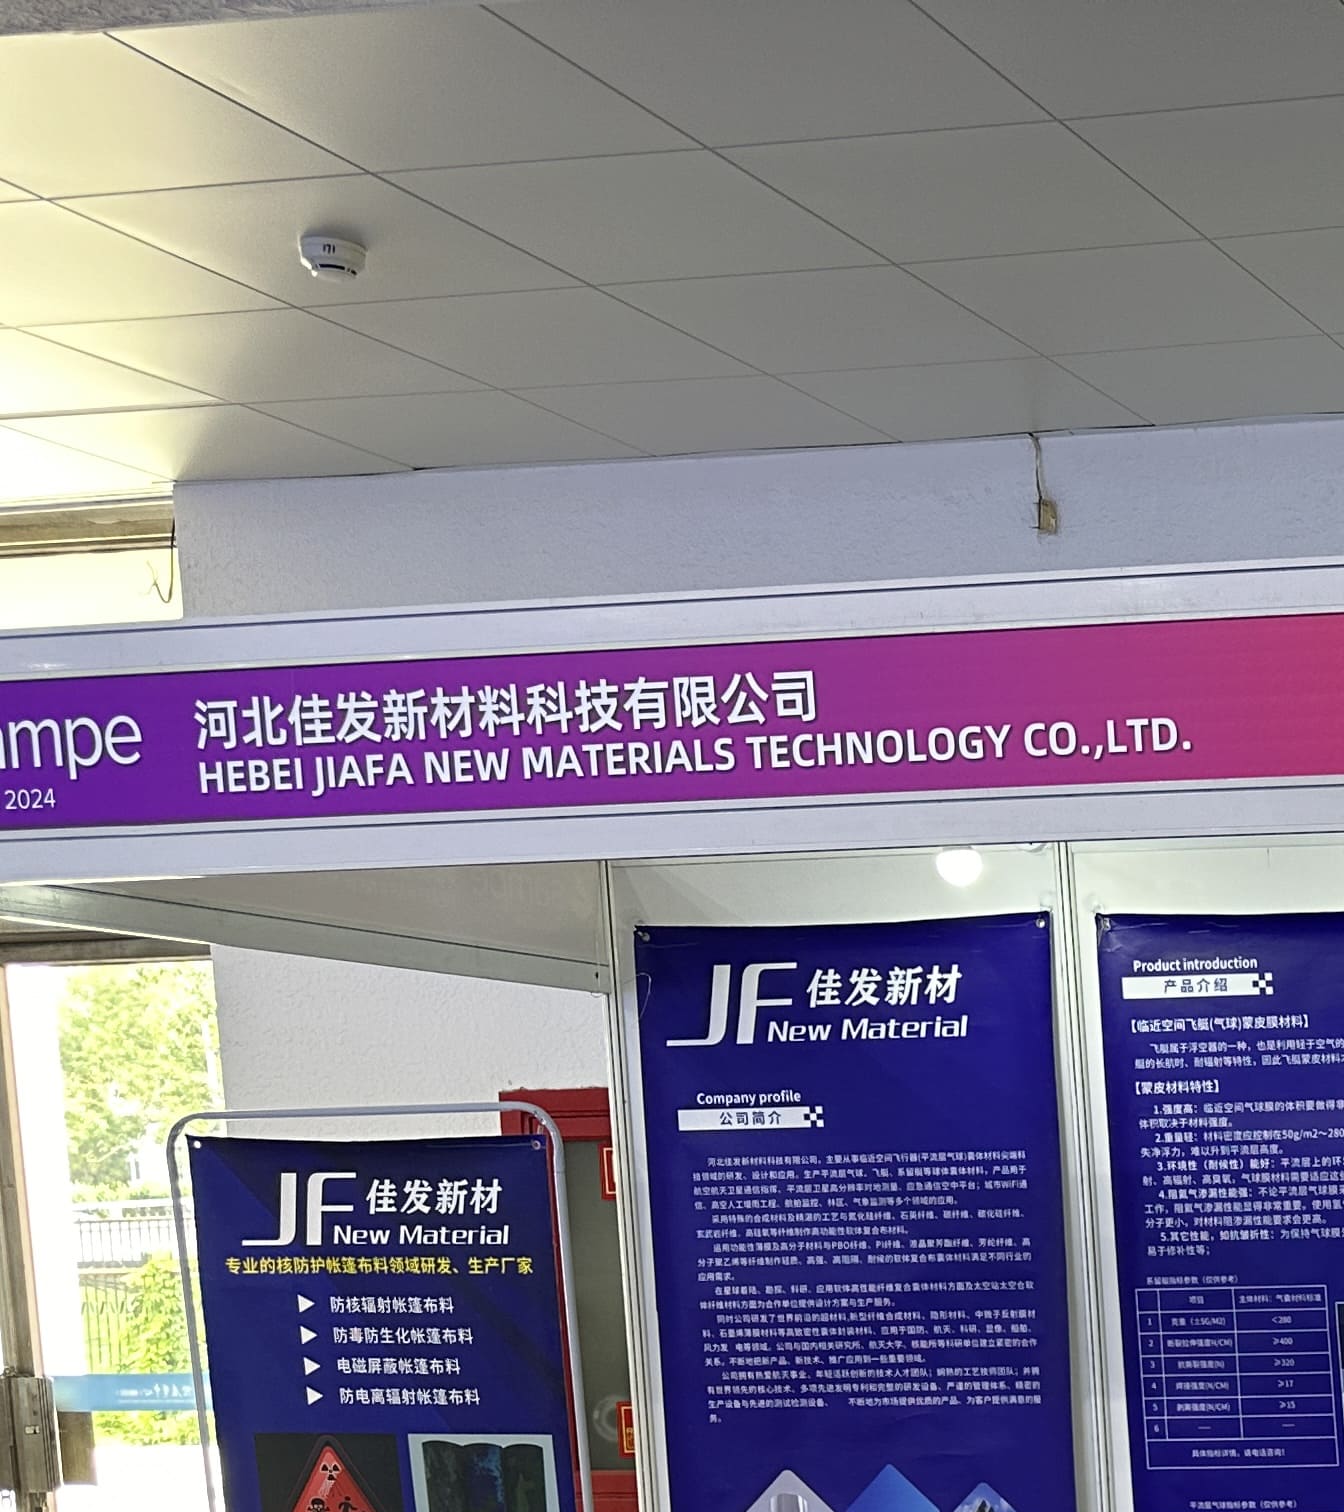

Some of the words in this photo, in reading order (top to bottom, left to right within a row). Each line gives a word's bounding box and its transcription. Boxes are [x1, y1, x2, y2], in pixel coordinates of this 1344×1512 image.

[194, 670, 817, 751] 河北佳发新材料科技有限公司
[0, 715, 141, 779] mpe
[198, 758, 304, 795] HEBEI
[311, 751, 414, 798] JIAFA
[424, 747, 511, 784] NEW
[521, 736, 736, 781] MATERIALS
[746, 723, 1012, 770] TECHNOLOGY
[1023, 717, 1193, 762] CO.,LTD.
[5, 789, 56, 811] 2024
[1133, 957, 1181, 973] Product
[1183, 956, 1258, 971] introduction
[806, 964, 963, 1009] 佳发新材
[1164, 978, 1228, 993] 产品介绍
[666, 962, 798, 1047] JF
[767, 1020, 833, 1043] New
[840, 1015, 968, 1041] Material
[1135, 1079, 1219, 1095] 【蒙皮材料特性】
[697, 1092, 756, 1107] Company
[759, 1090, 802, 1105] profile
[719, 1111, 782, 1126] 公司简介
[366, 1178, 503, 1216] 佳发新材
[241, 1172, 357, 1247] JF
[334, 1226, 390, 1245] New
[399, 1225, 508, 1245] Material
[330, 1296, 454, 1315] 防核辐射帐篷布料
[333, 1327, 473, 1346] 防毒防生化帐篷布料
[337, 1358, 461, 1376] 电磁屏蔽帐篷布料
[339, 1388, 481, 1406] 防电离辐射帐篷布料
